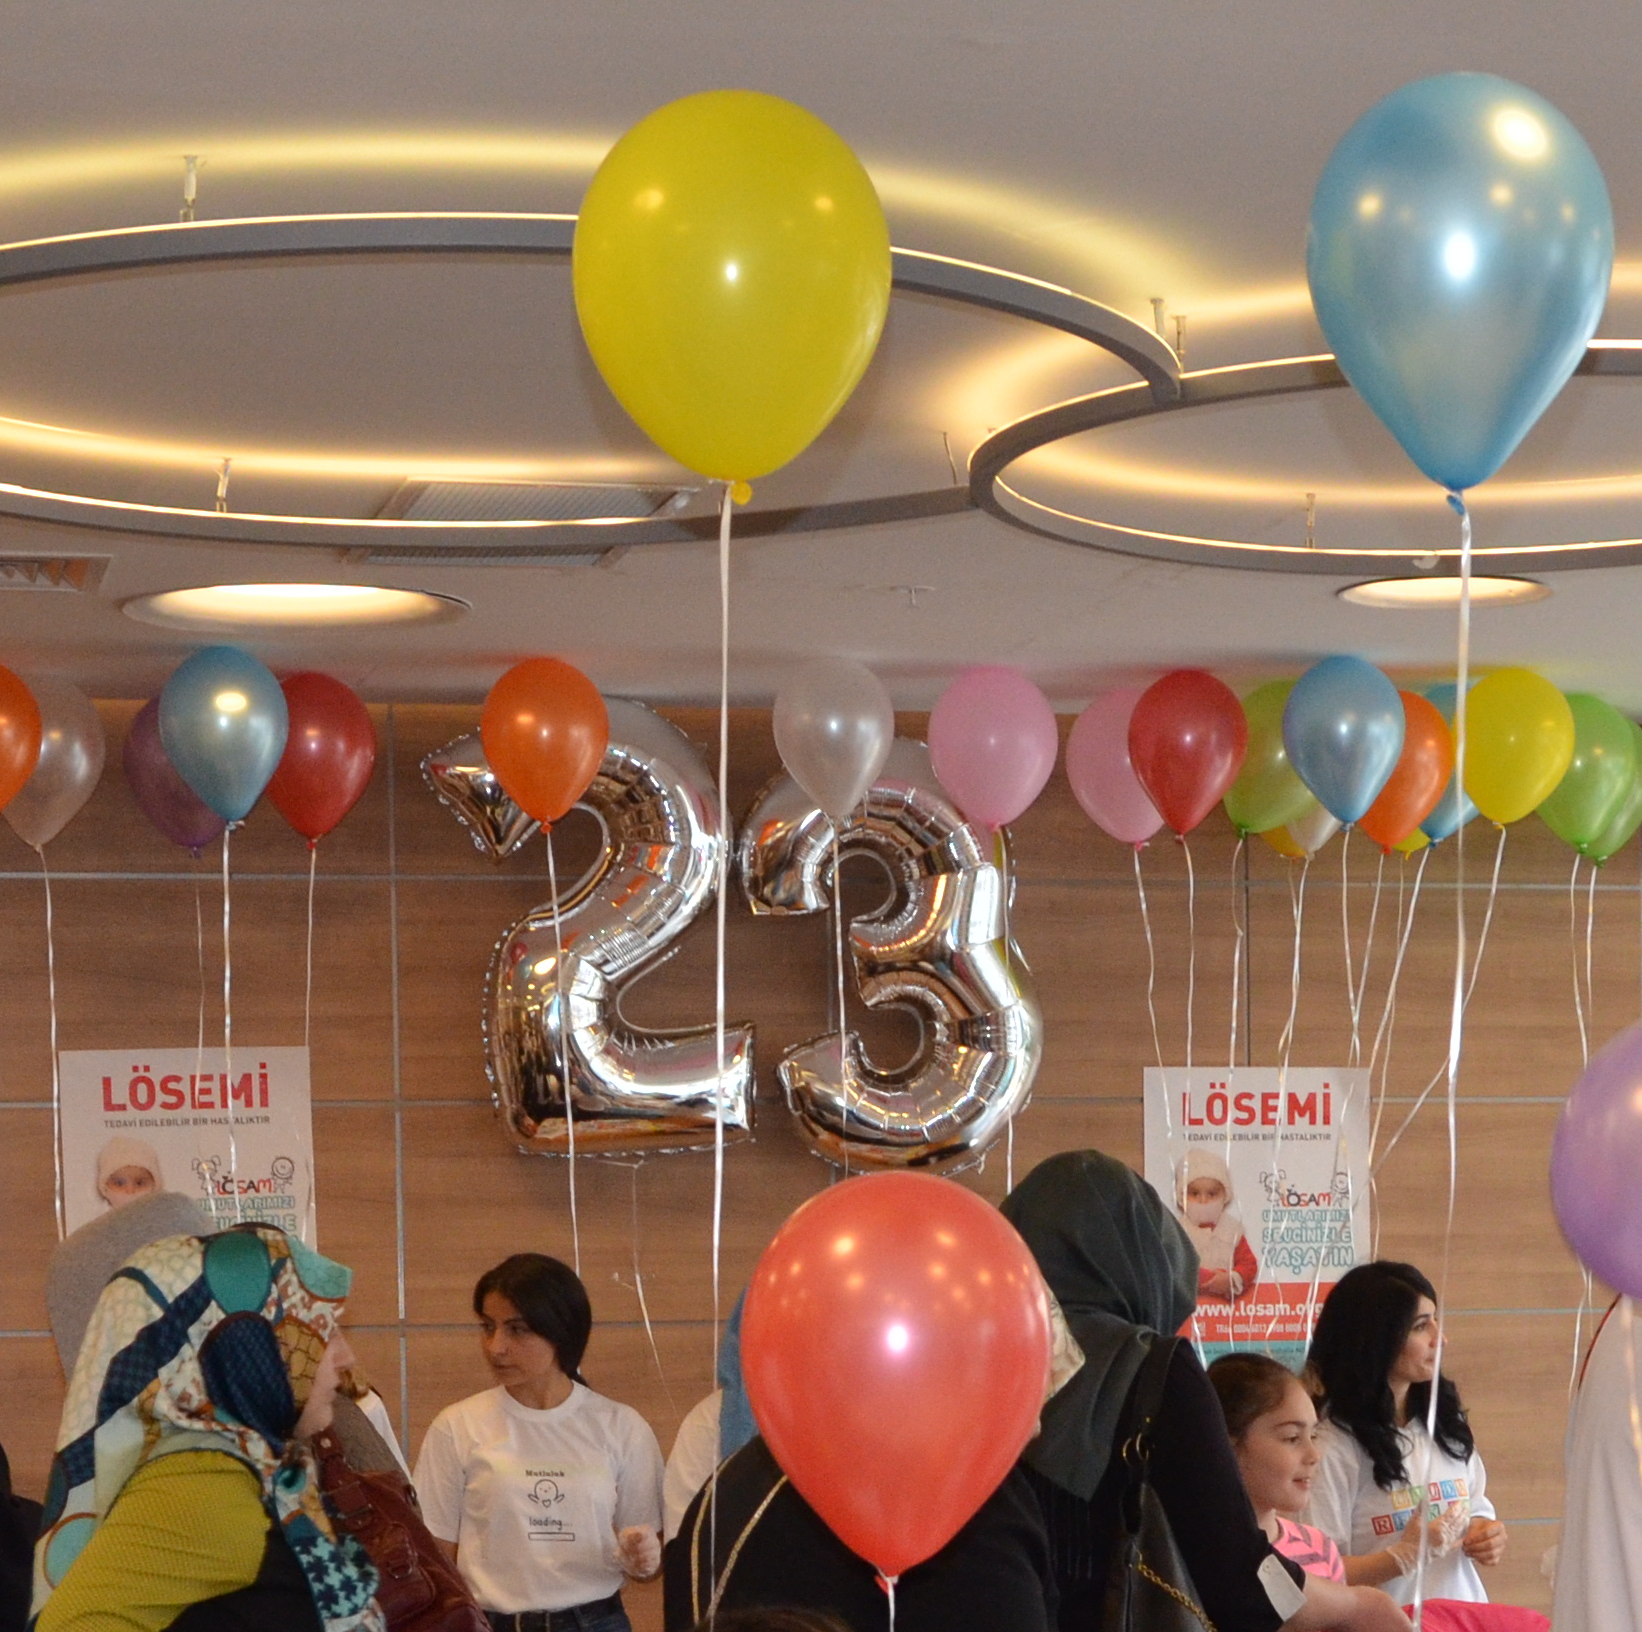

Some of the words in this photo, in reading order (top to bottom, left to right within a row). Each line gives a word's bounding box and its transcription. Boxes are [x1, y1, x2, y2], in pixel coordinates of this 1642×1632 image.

[102, 1062, 269, 1112] LÖSEMİ
[1182, 1082, 1331, 1126] LÖSEMİ
[104, 1118, 138, 1129] TEDAVİ
[139, 1116, 191, 1128] EDİLEBİLİR
[192, 1116, 208, 1127] BİR
[210, 1115, 270, 1126] HASALIKTIR
